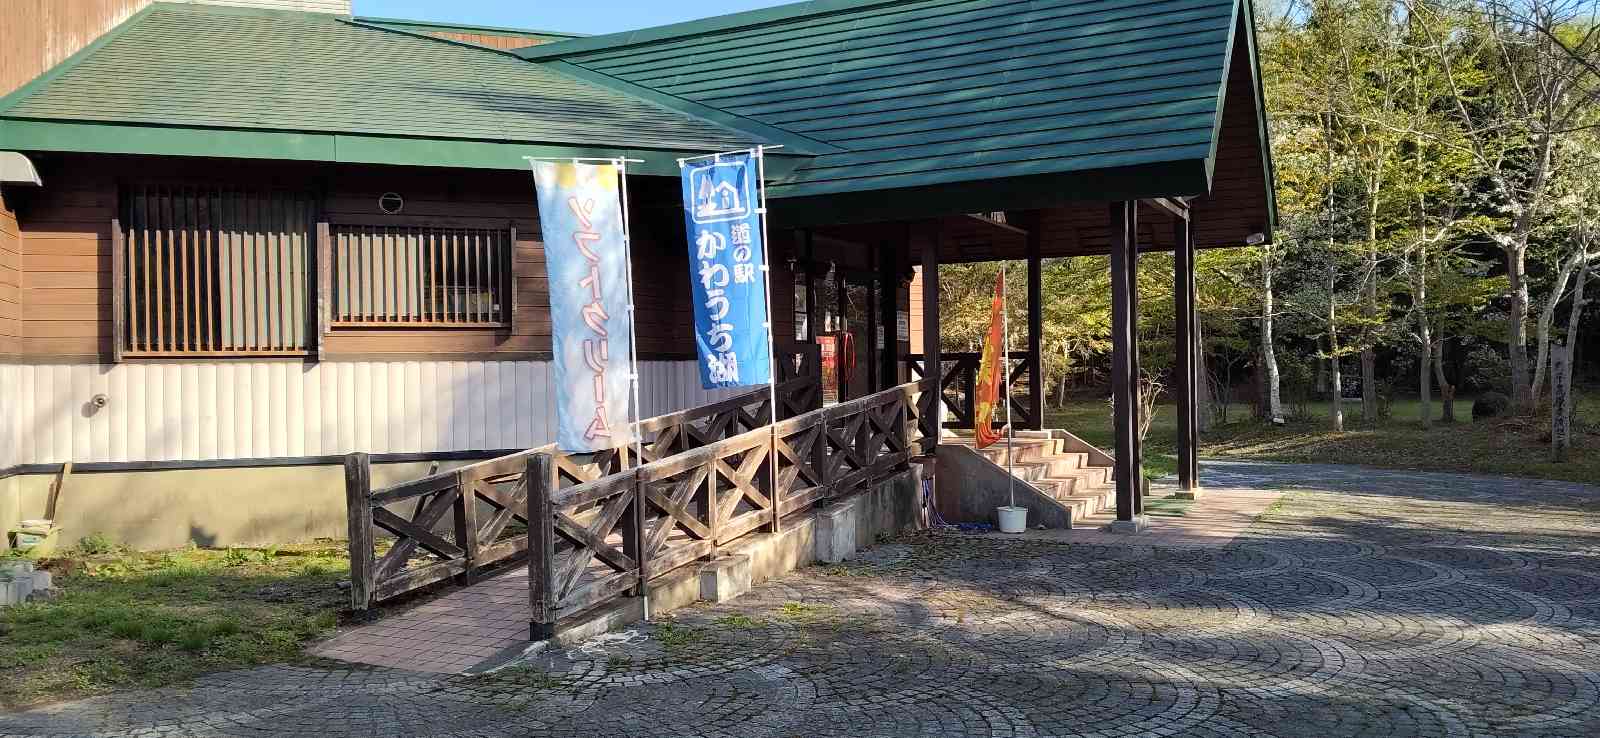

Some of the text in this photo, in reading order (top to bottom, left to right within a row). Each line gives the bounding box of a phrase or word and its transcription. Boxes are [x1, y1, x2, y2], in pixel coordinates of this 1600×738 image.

[696, 229, 739, 384] かわうち湖
[732, 222, 755, 284] 道の駅
